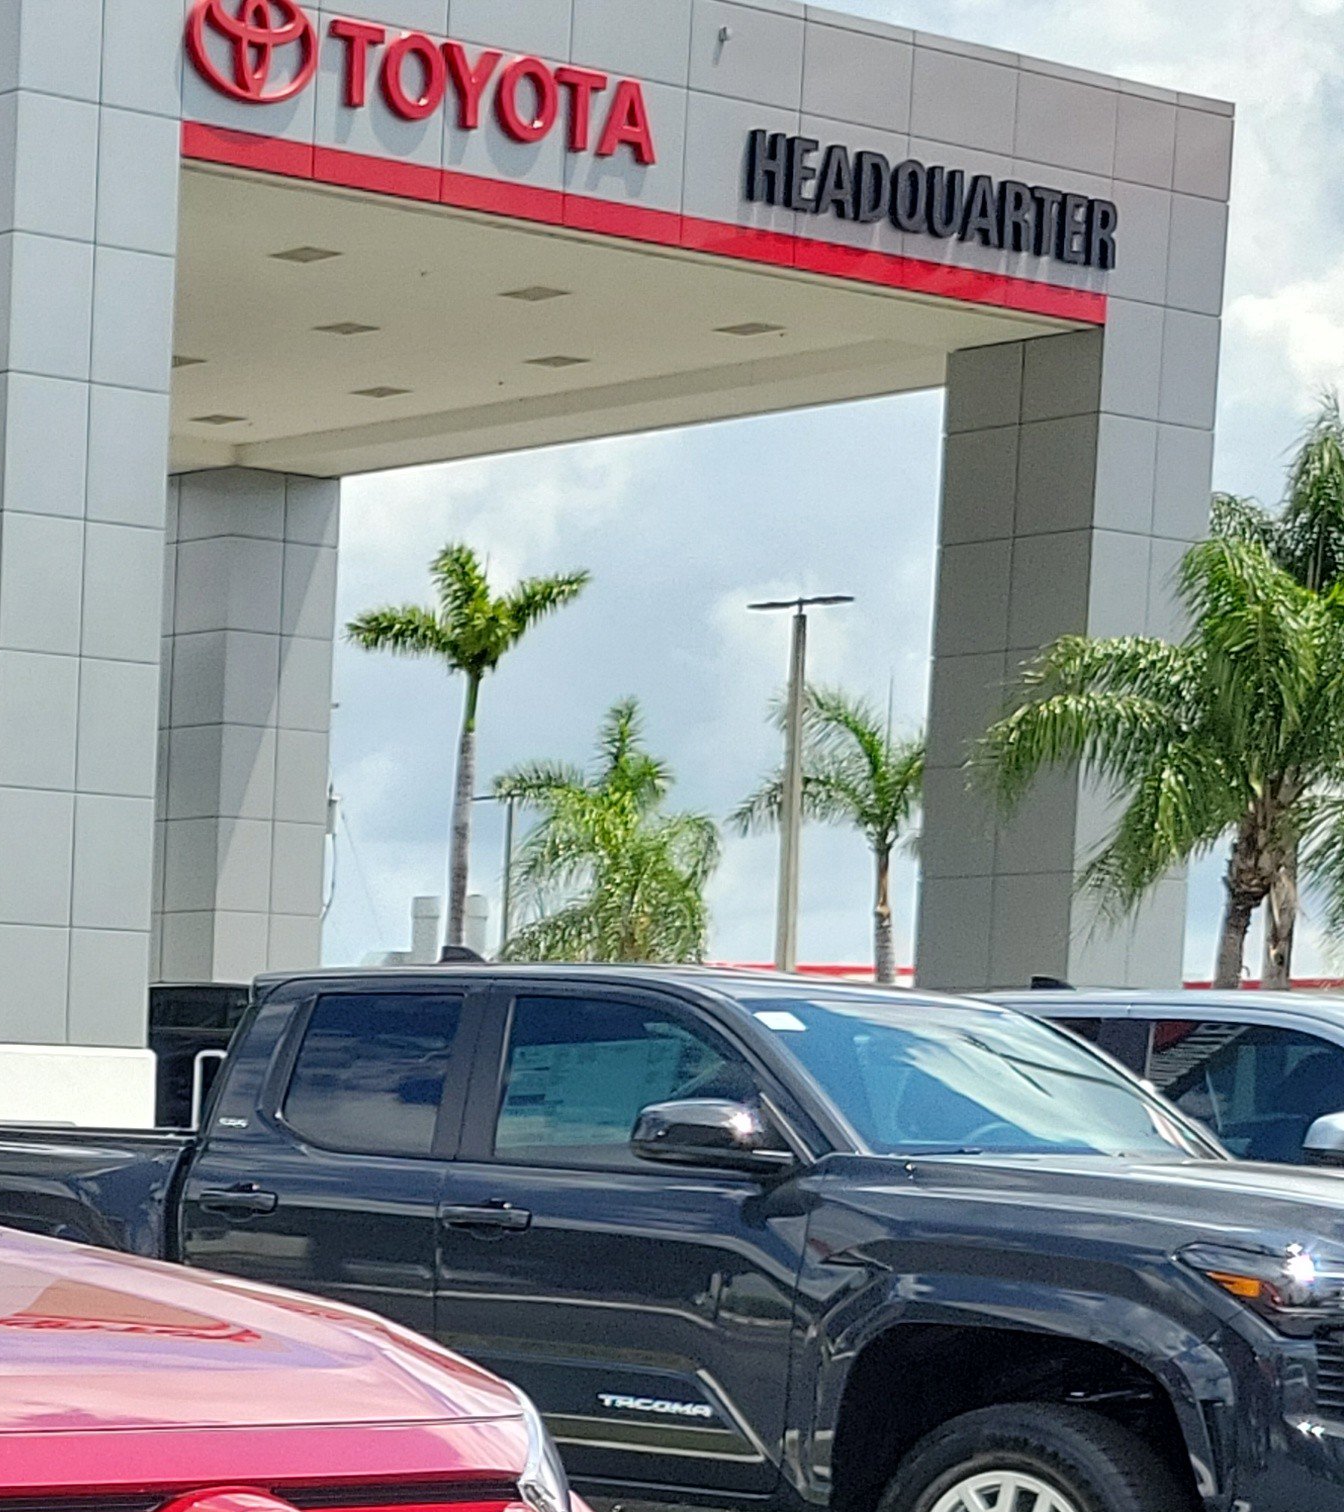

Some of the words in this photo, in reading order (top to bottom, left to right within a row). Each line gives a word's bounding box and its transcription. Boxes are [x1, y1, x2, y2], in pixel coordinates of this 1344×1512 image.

[327, 17, 656, 166] TOYOTA
[745, 129, 1118, 270] HEADQUARTER
[597, 1394, 713, 1418] TACOMA
